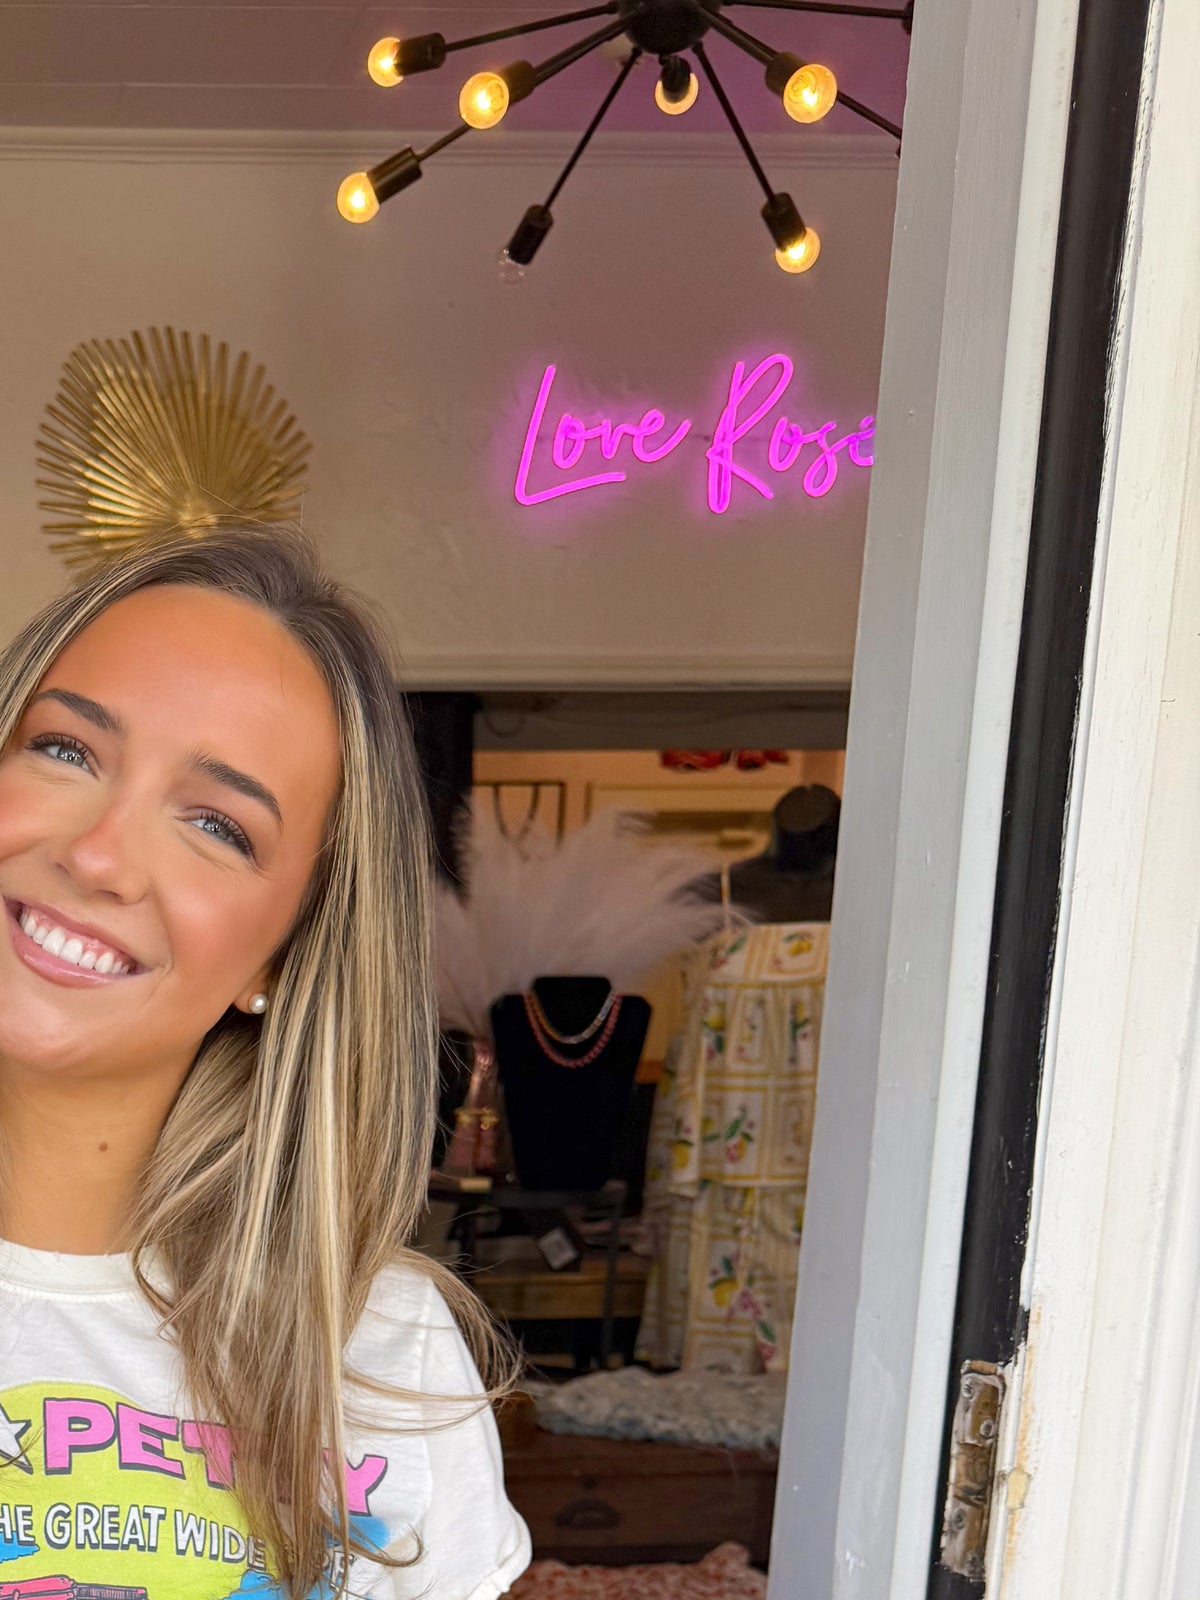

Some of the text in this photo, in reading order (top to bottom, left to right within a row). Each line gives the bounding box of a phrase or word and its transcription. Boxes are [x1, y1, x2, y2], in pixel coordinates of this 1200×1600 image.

[514, 363, 692, 506] Love
[43, 1397, 388, 1517] PETY
[46, 1503, 168, 1552] GREAT
[174, 1509, 267, 1572] WIDE
